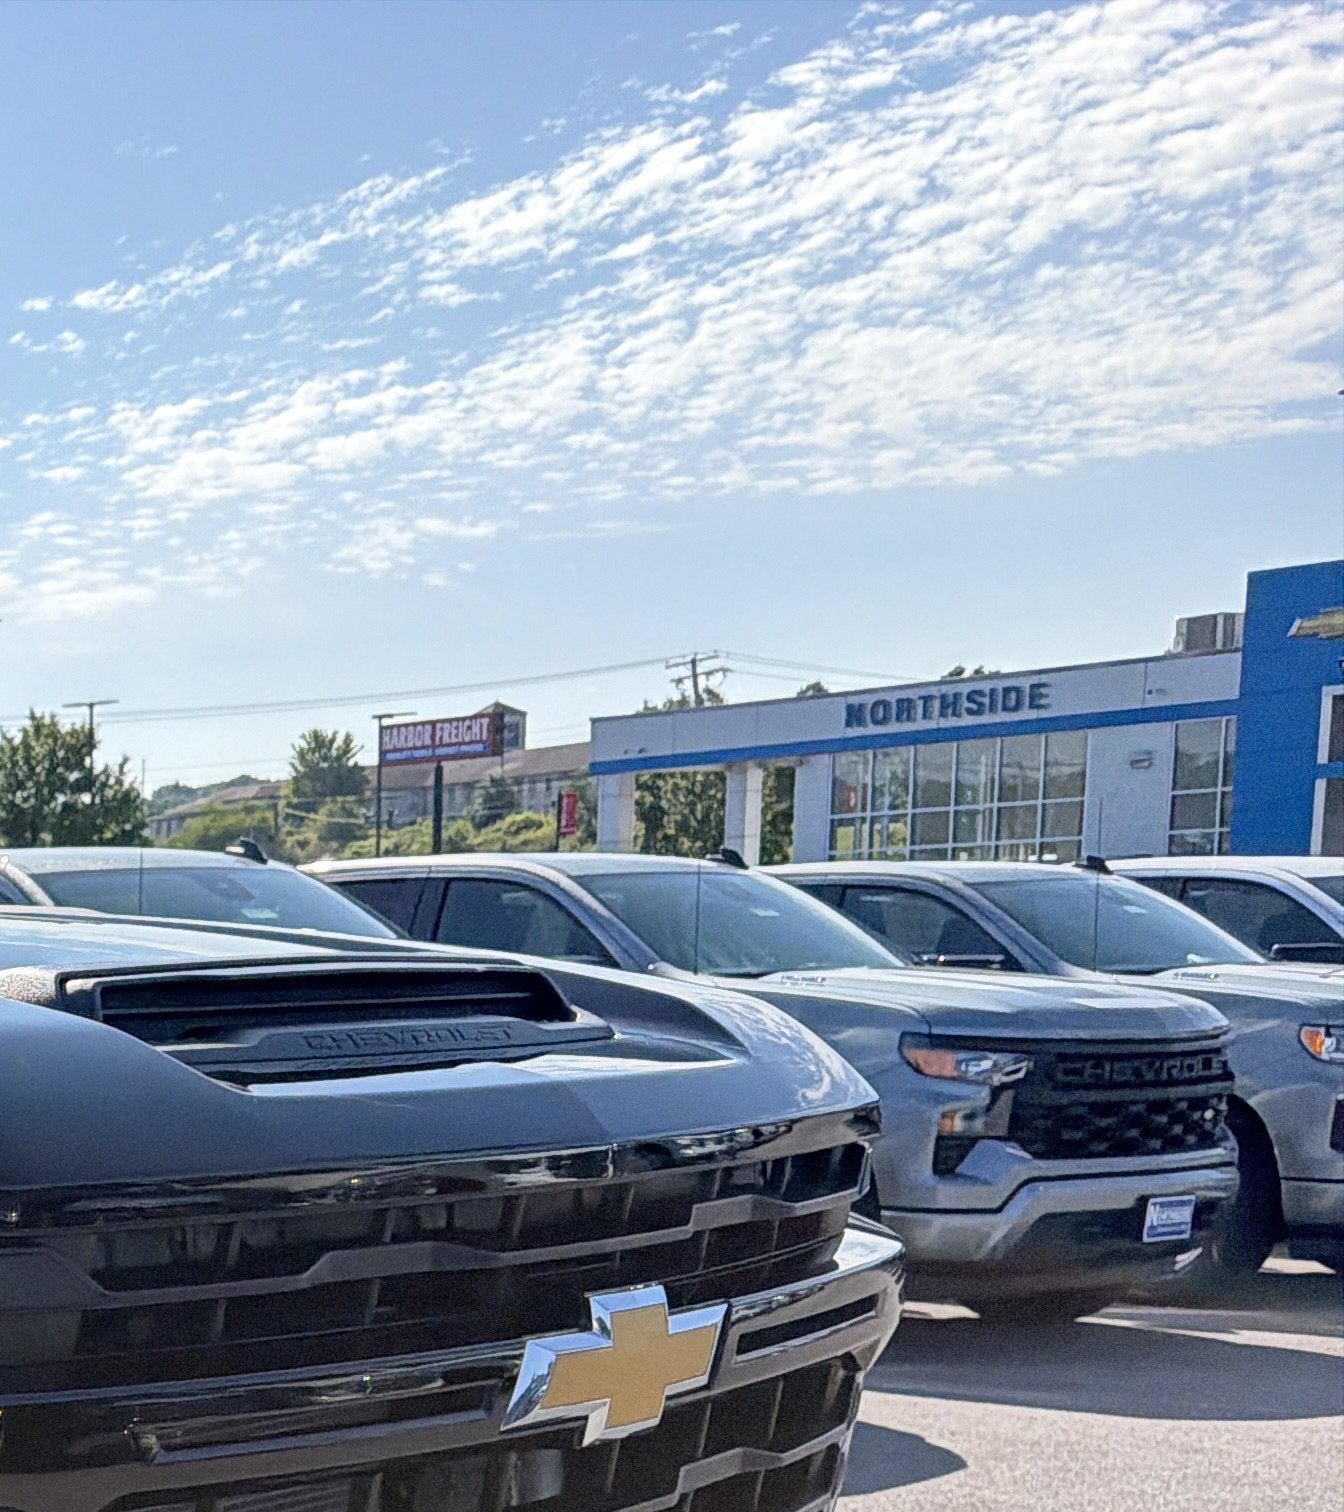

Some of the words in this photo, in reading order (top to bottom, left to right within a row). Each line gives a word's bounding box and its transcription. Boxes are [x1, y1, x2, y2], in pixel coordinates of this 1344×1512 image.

[844, 682, 1052, 728] NORTHSIDE
[382, 724, 433, 751] HARBOR
[435, 717, 490, 745] FREIGHT
[303, 1025, 512, 1051] CHEVROLET
